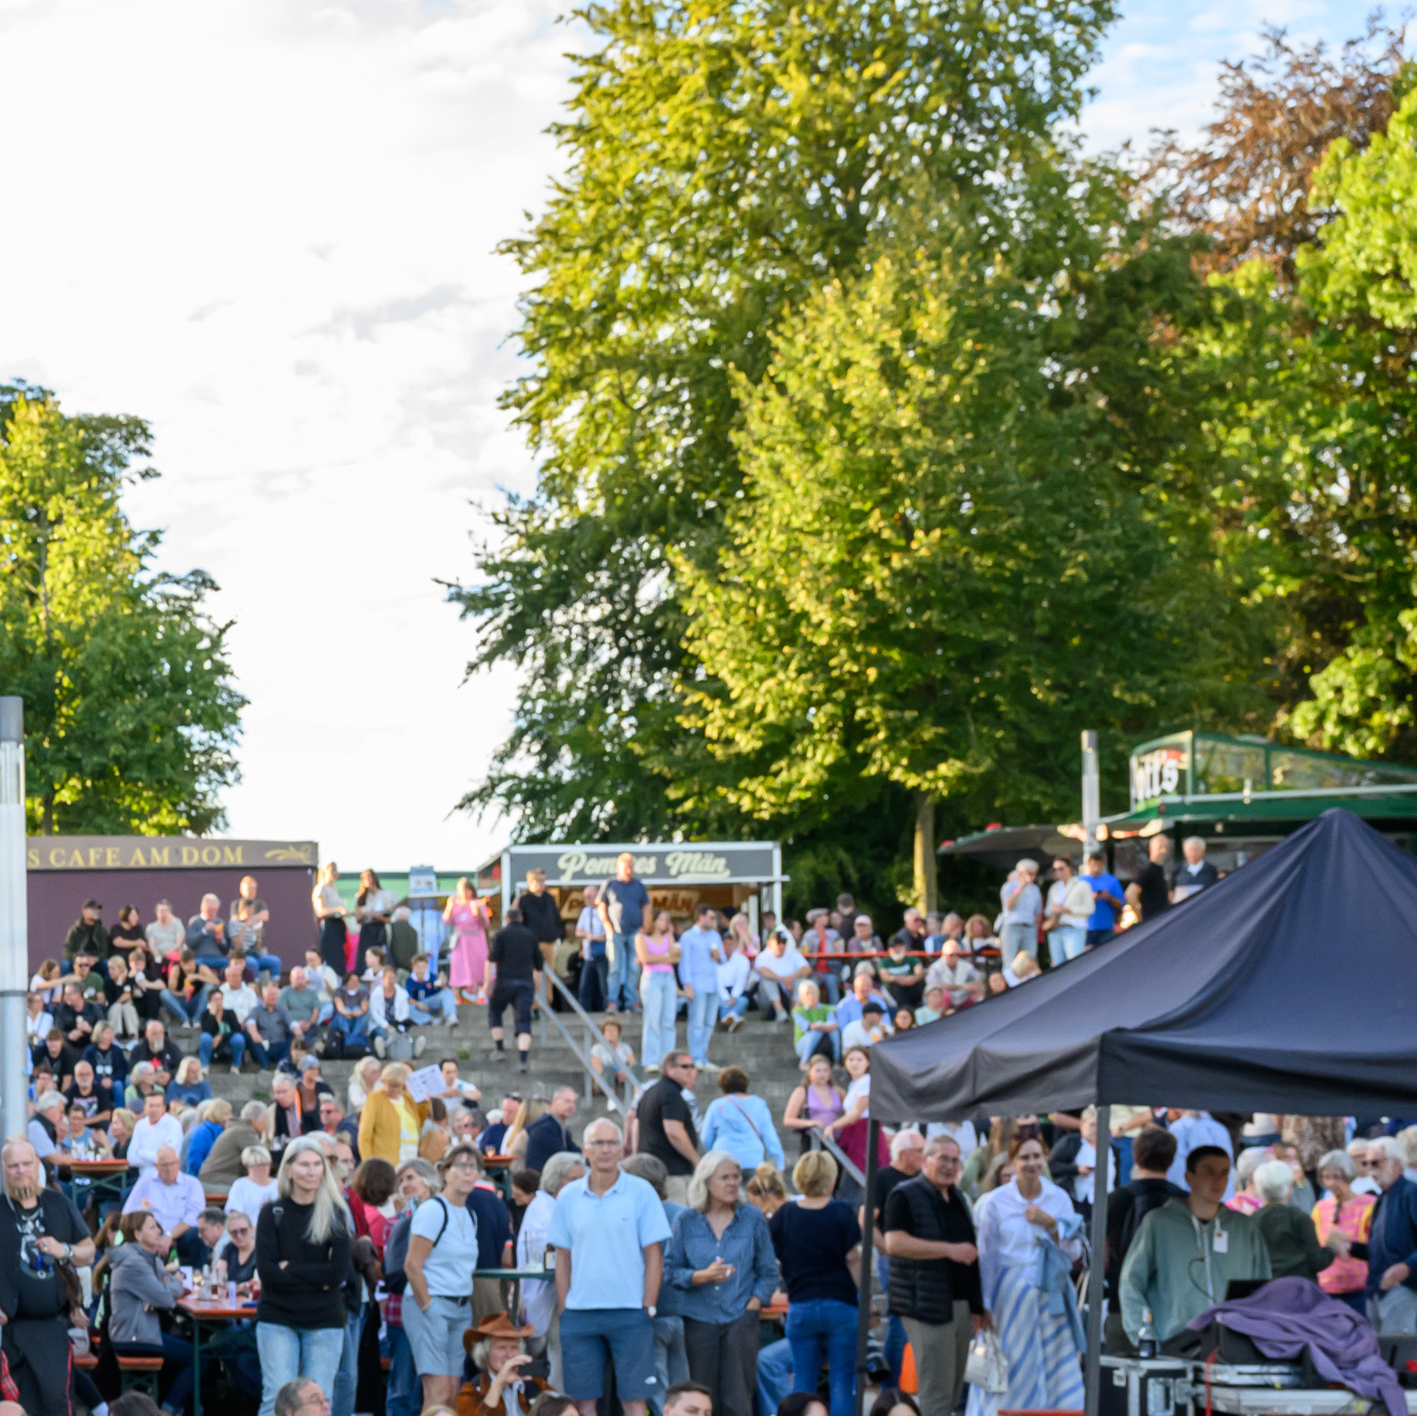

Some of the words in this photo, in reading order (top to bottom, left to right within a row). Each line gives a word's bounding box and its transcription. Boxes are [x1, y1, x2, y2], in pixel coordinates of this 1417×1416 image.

[49, 848, 121, 867] CAFE
[129, 847, 170, 866] AM
[181, 846, 244, 866] DOM
[557, 851, 657, 883] Pomes
